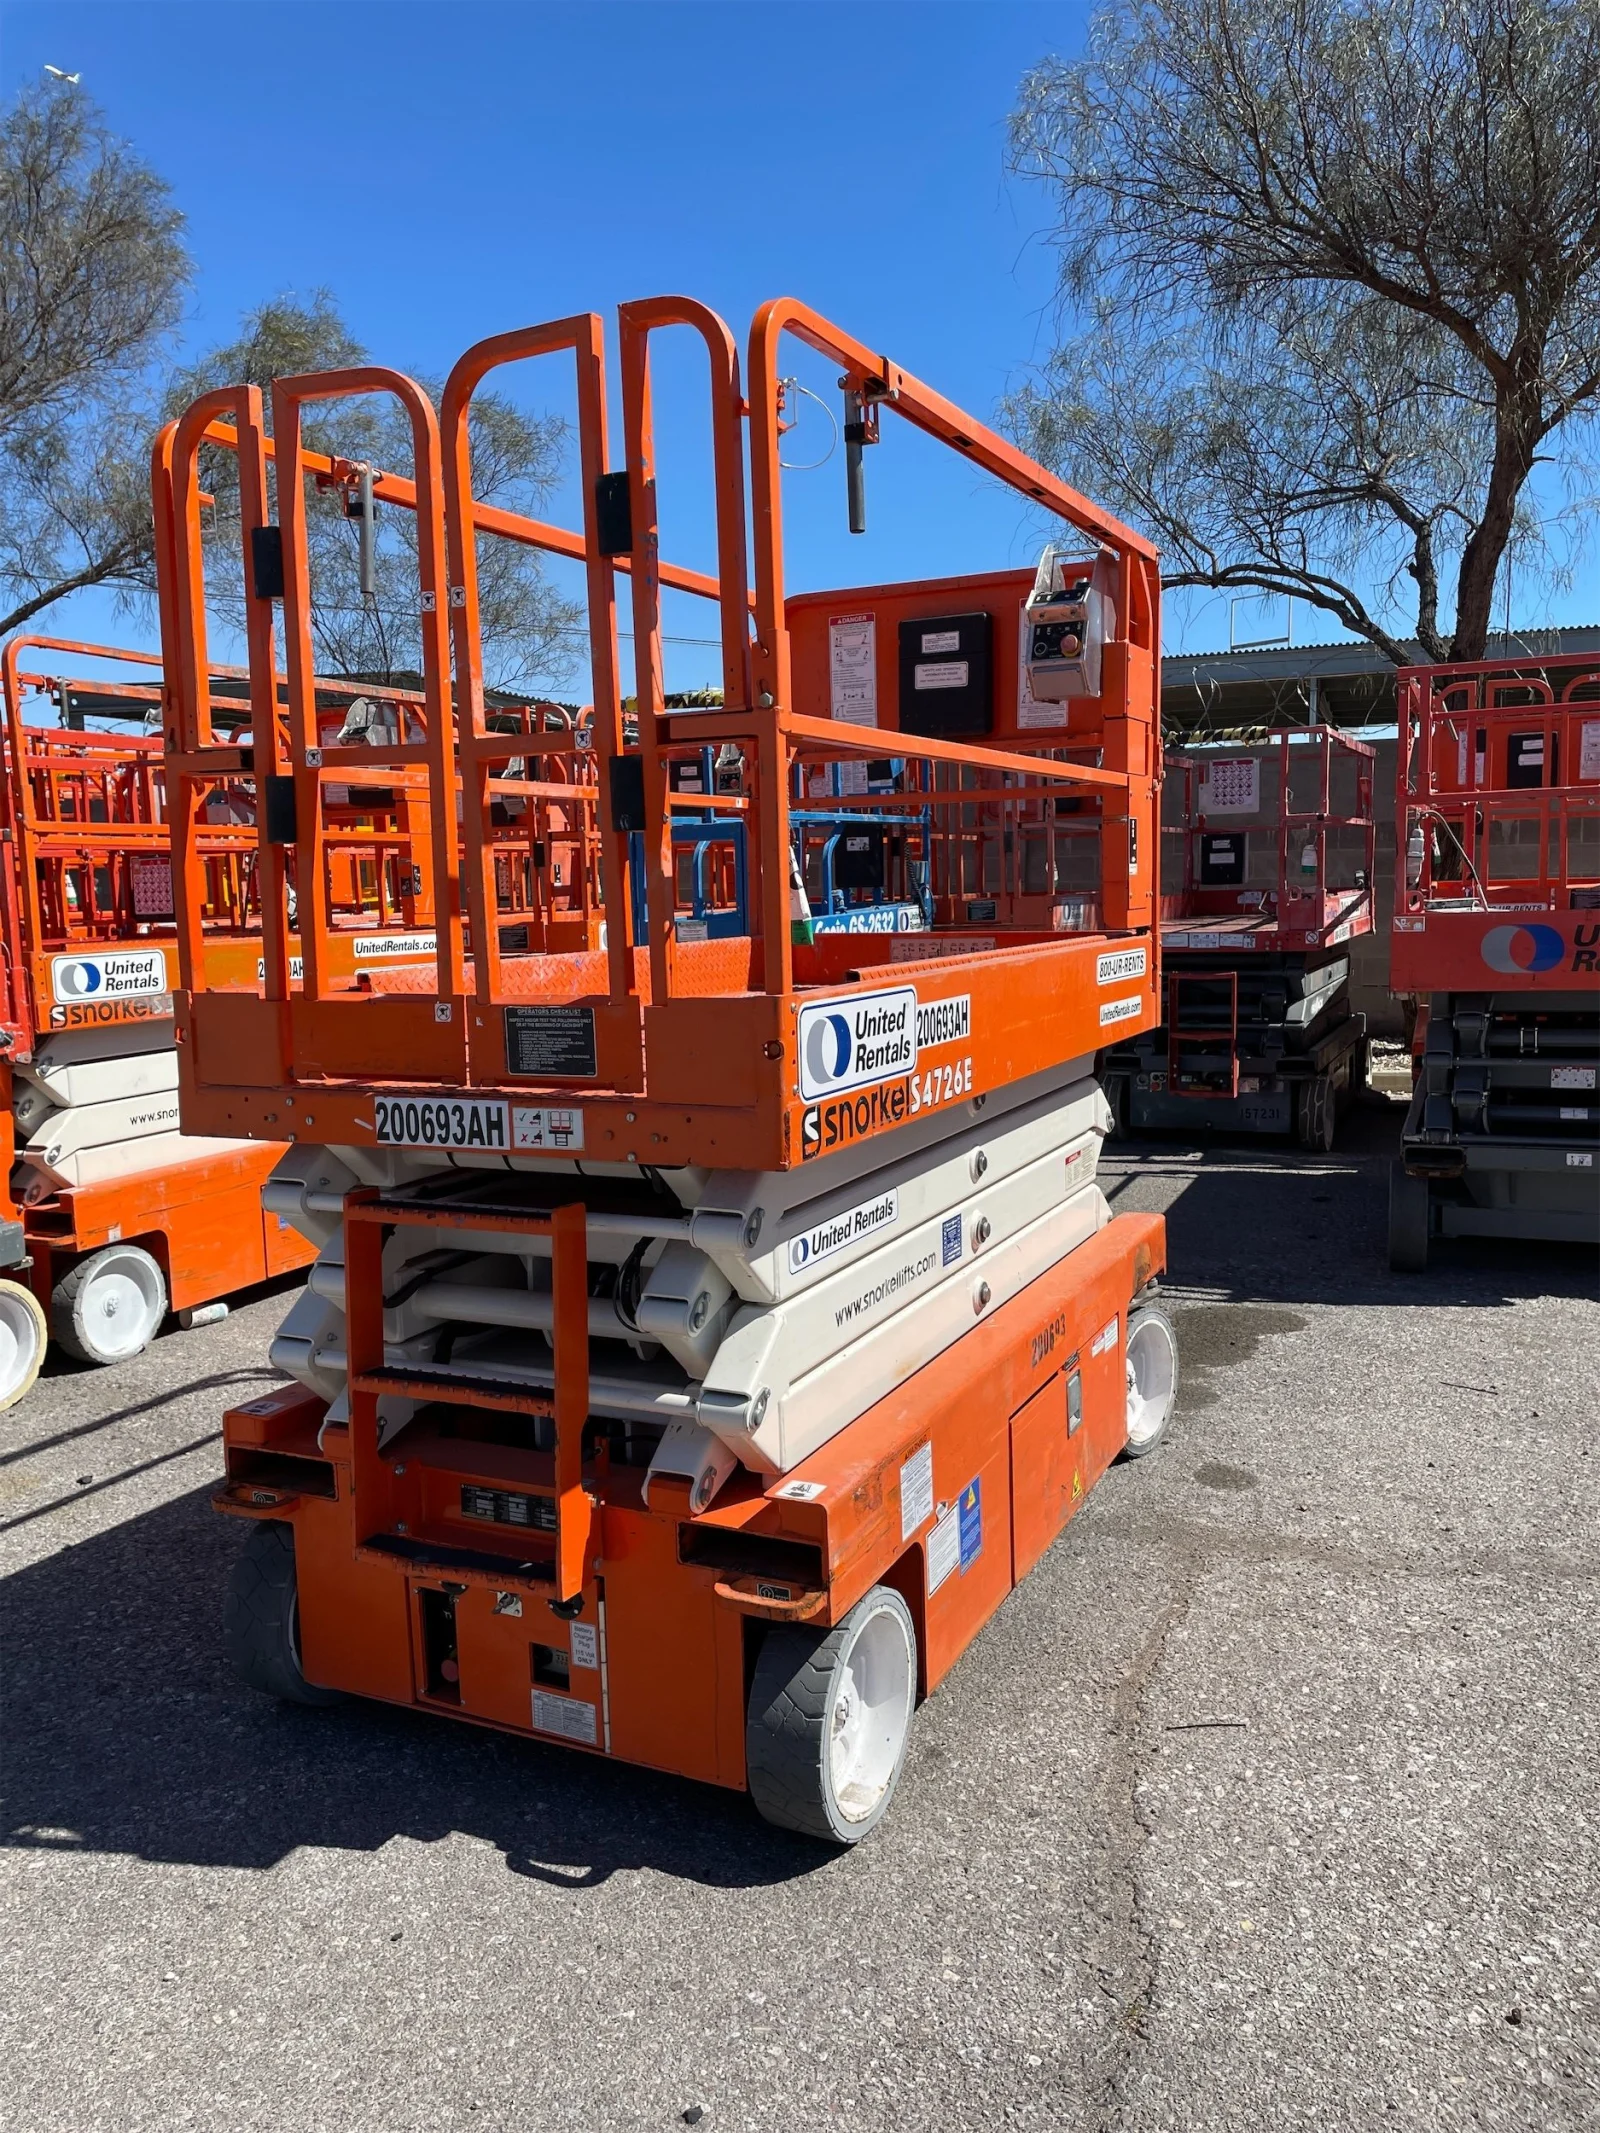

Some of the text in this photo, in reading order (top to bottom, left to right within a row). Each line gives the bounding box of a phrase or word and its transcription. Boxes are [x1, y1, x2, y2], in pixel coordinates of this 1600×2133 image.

[356, 939, 437, 954] UnitedRentals.co
[1100, 954, 1144, 978] 800-UR-RENTS
[105, 958, 153, 976] United
[105, 975, 159, 992] Rentals
[855, 1002, 907, 1040] United
[917, 999, 968, 1048] 200693AH
[1101, 1002, 1141, 1022] UnitedRentals.com
[855, 1034, 911, 1073] Rentals
[911, 1056, 973, 1115] S4726E
[376, 1102, 504, 1147] 200693AH
[824, 1076, 911, 1147] snorkel
[812, 1197, 894, 1256] United Rentals
[834, 1252, 937, 1327] www.snorkellifts.com
